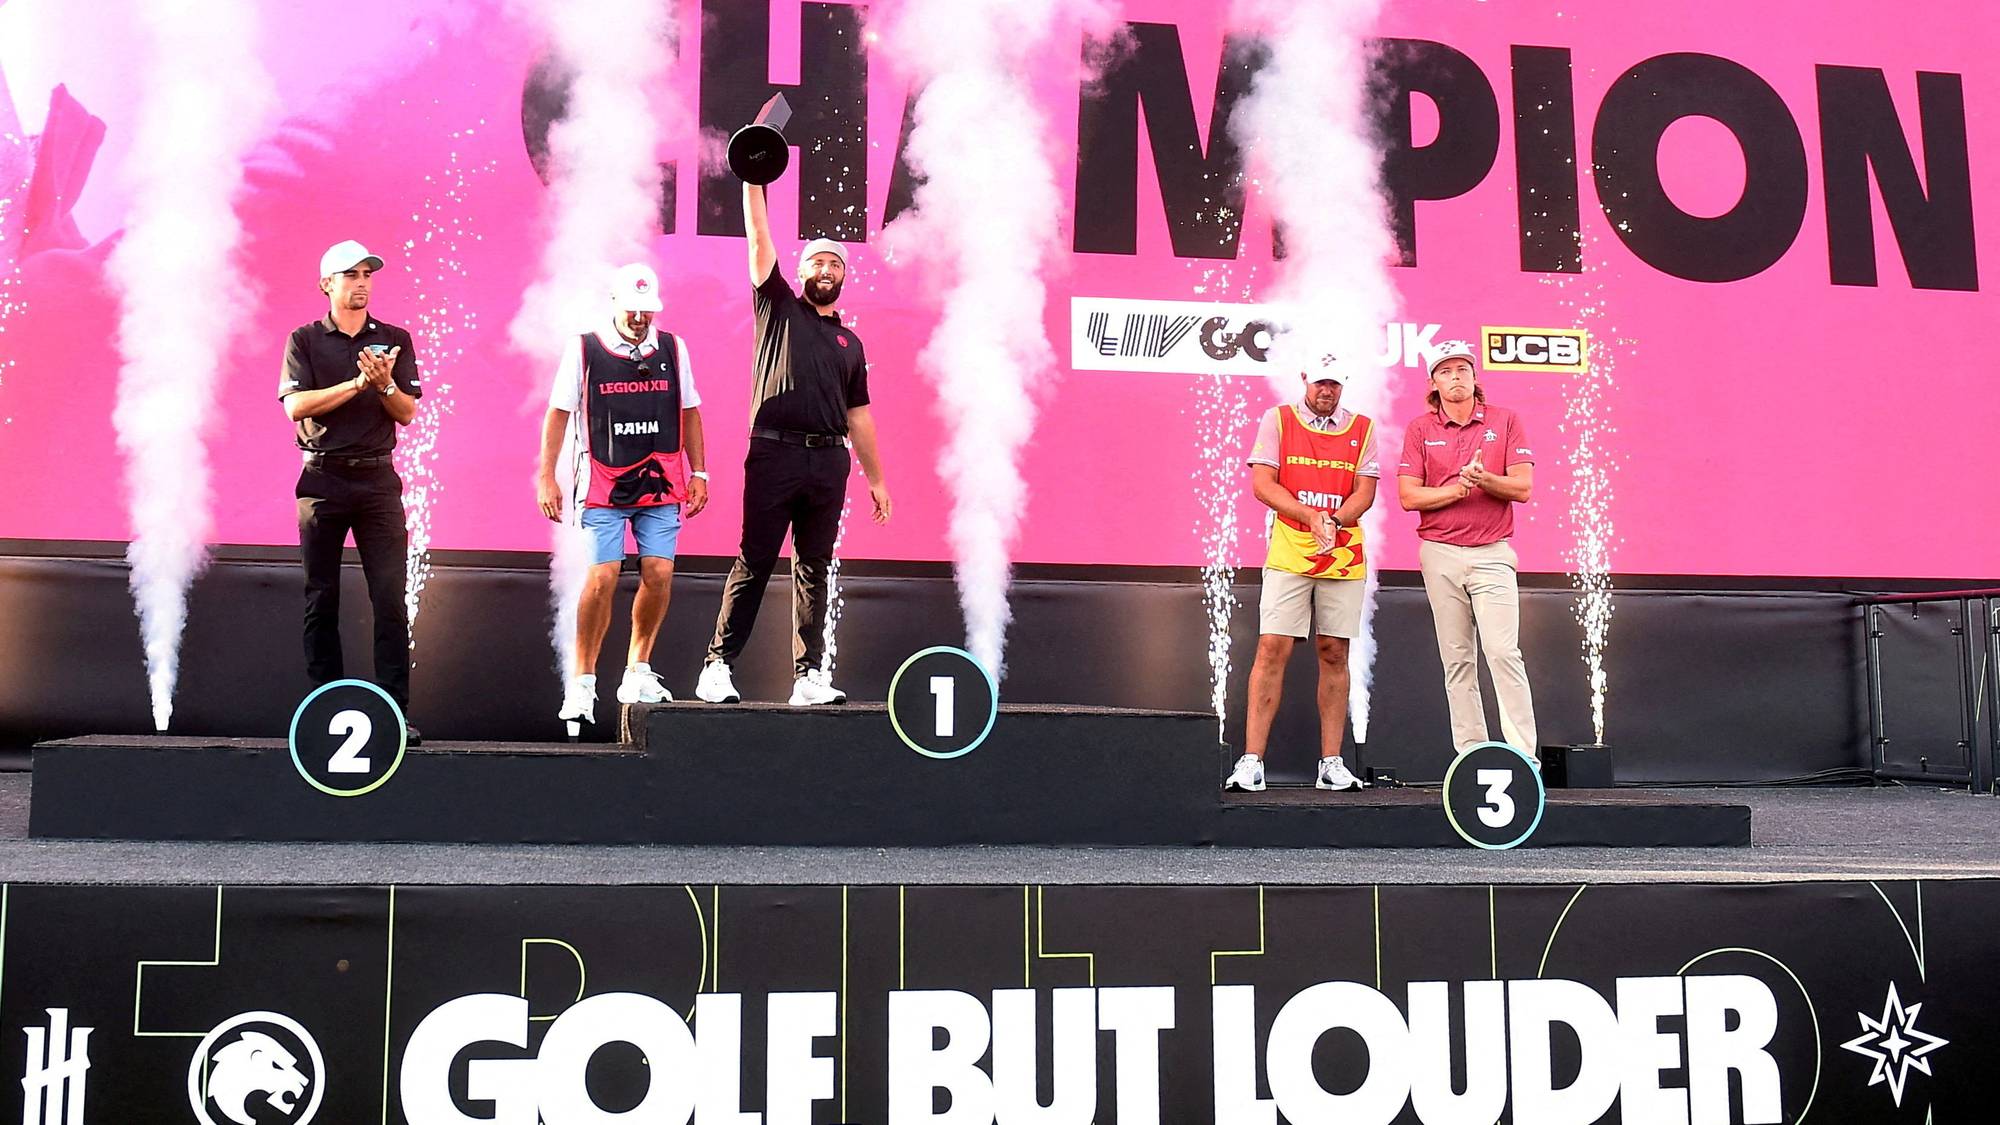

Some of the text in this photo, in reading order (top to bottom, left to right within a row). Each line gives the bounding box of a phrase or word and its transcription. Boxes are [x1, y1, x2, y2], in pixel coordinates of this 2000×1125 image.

[522, 0, 1979, 292] HMPION
[1087, 312, 1201, 358] LIV
[1490, 335, 1581, 364] JCB
[599, 382, 648, 394] LEGION
[614, 420, 659, 436] RAHM
[1286, 456, 1355, 471] RIPPER
[930, 676, 954, 737] 1
[328, 709, 372, 773] 2
[1476, 769, 1515, 828] 3
[401, 974, 1784, 1125] GOLF BUT LOUDER
